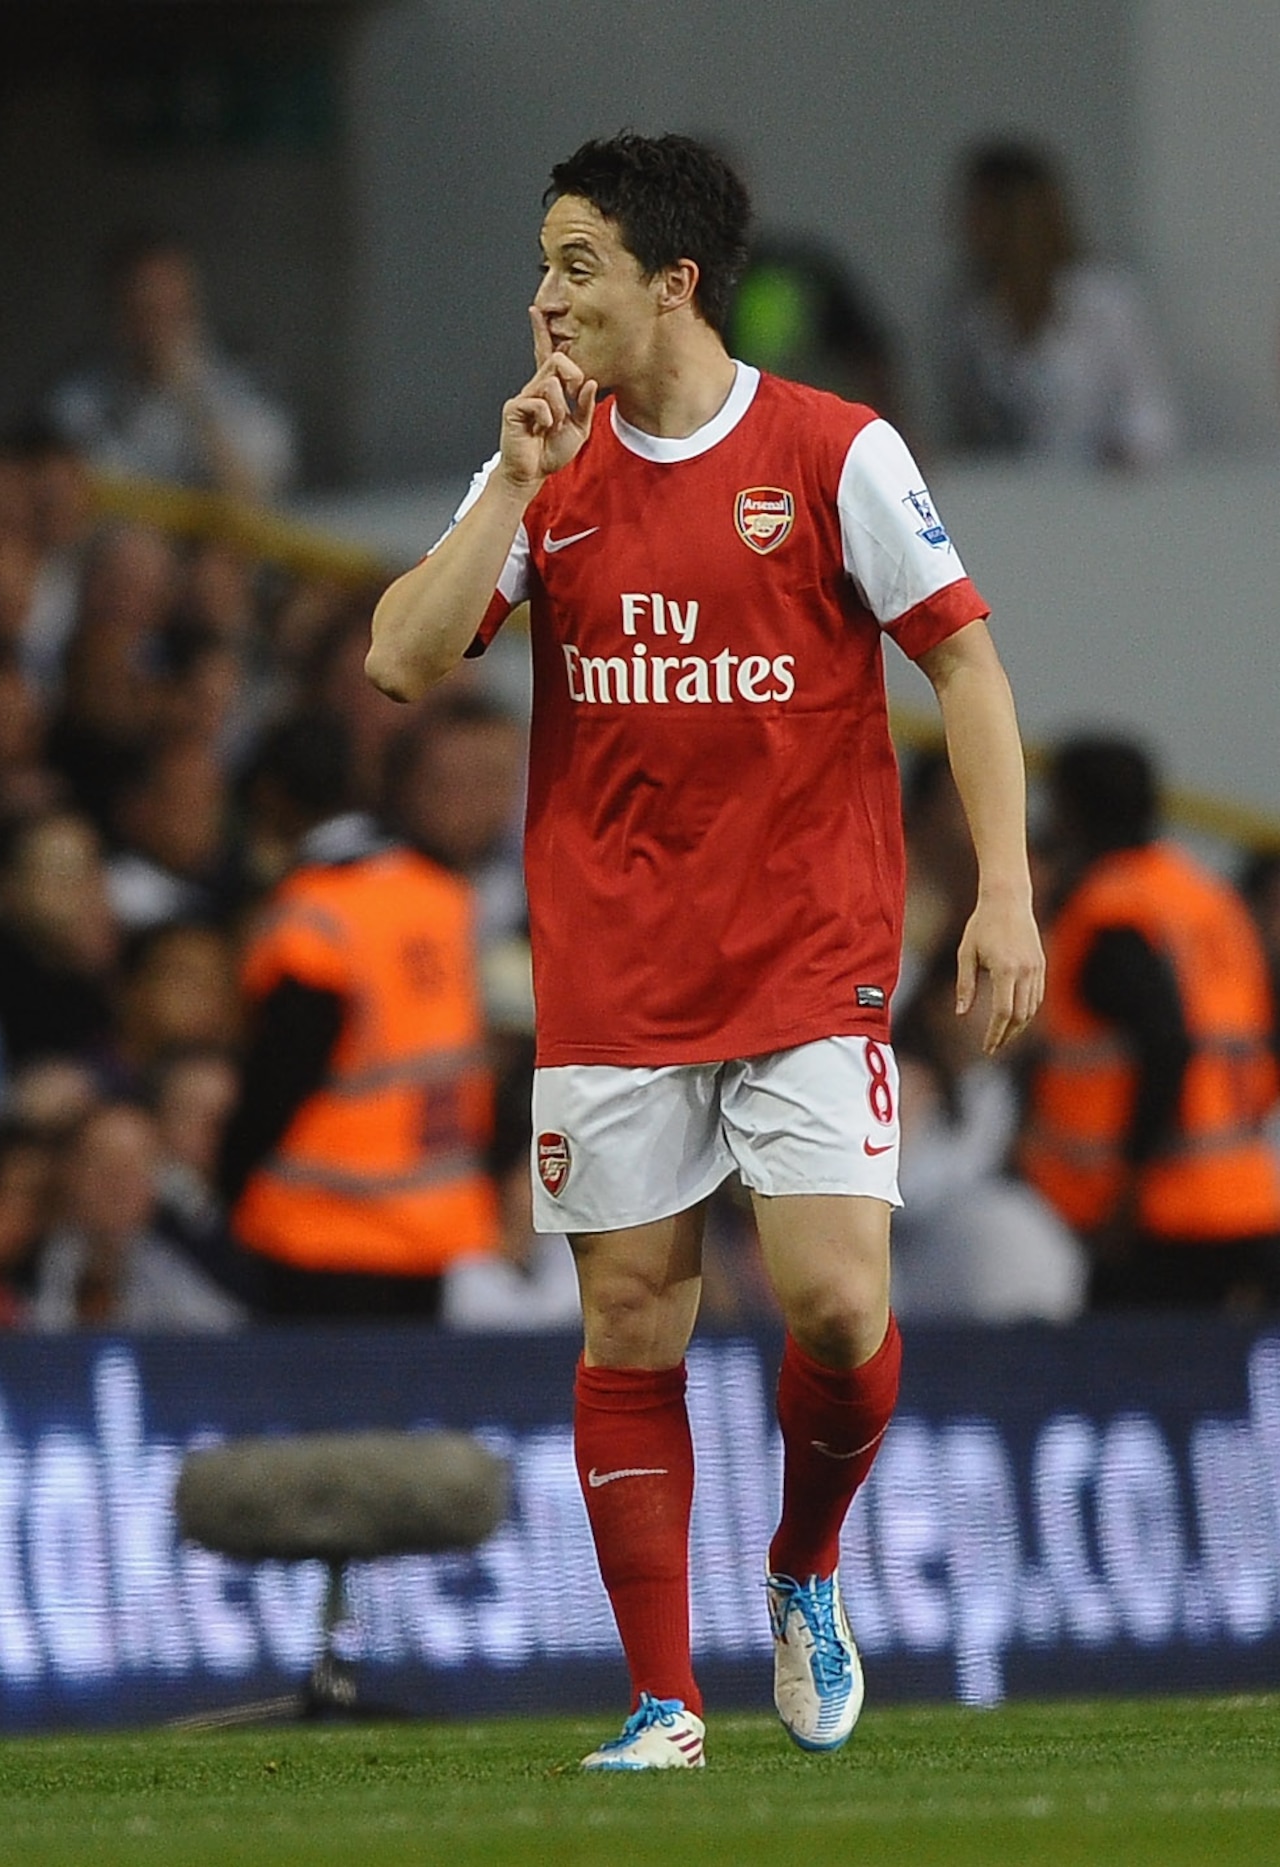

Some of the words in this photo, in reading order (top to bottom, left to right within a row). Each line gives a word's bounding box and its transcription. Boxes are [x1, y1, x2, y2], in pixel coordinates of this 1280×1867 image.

[743, 498, 785, 510] Arsenal
[620, 593, 699, 644] Fly
[562, 642, 795, 704] Emirates
[864, 1040, 894, 1126] 8
